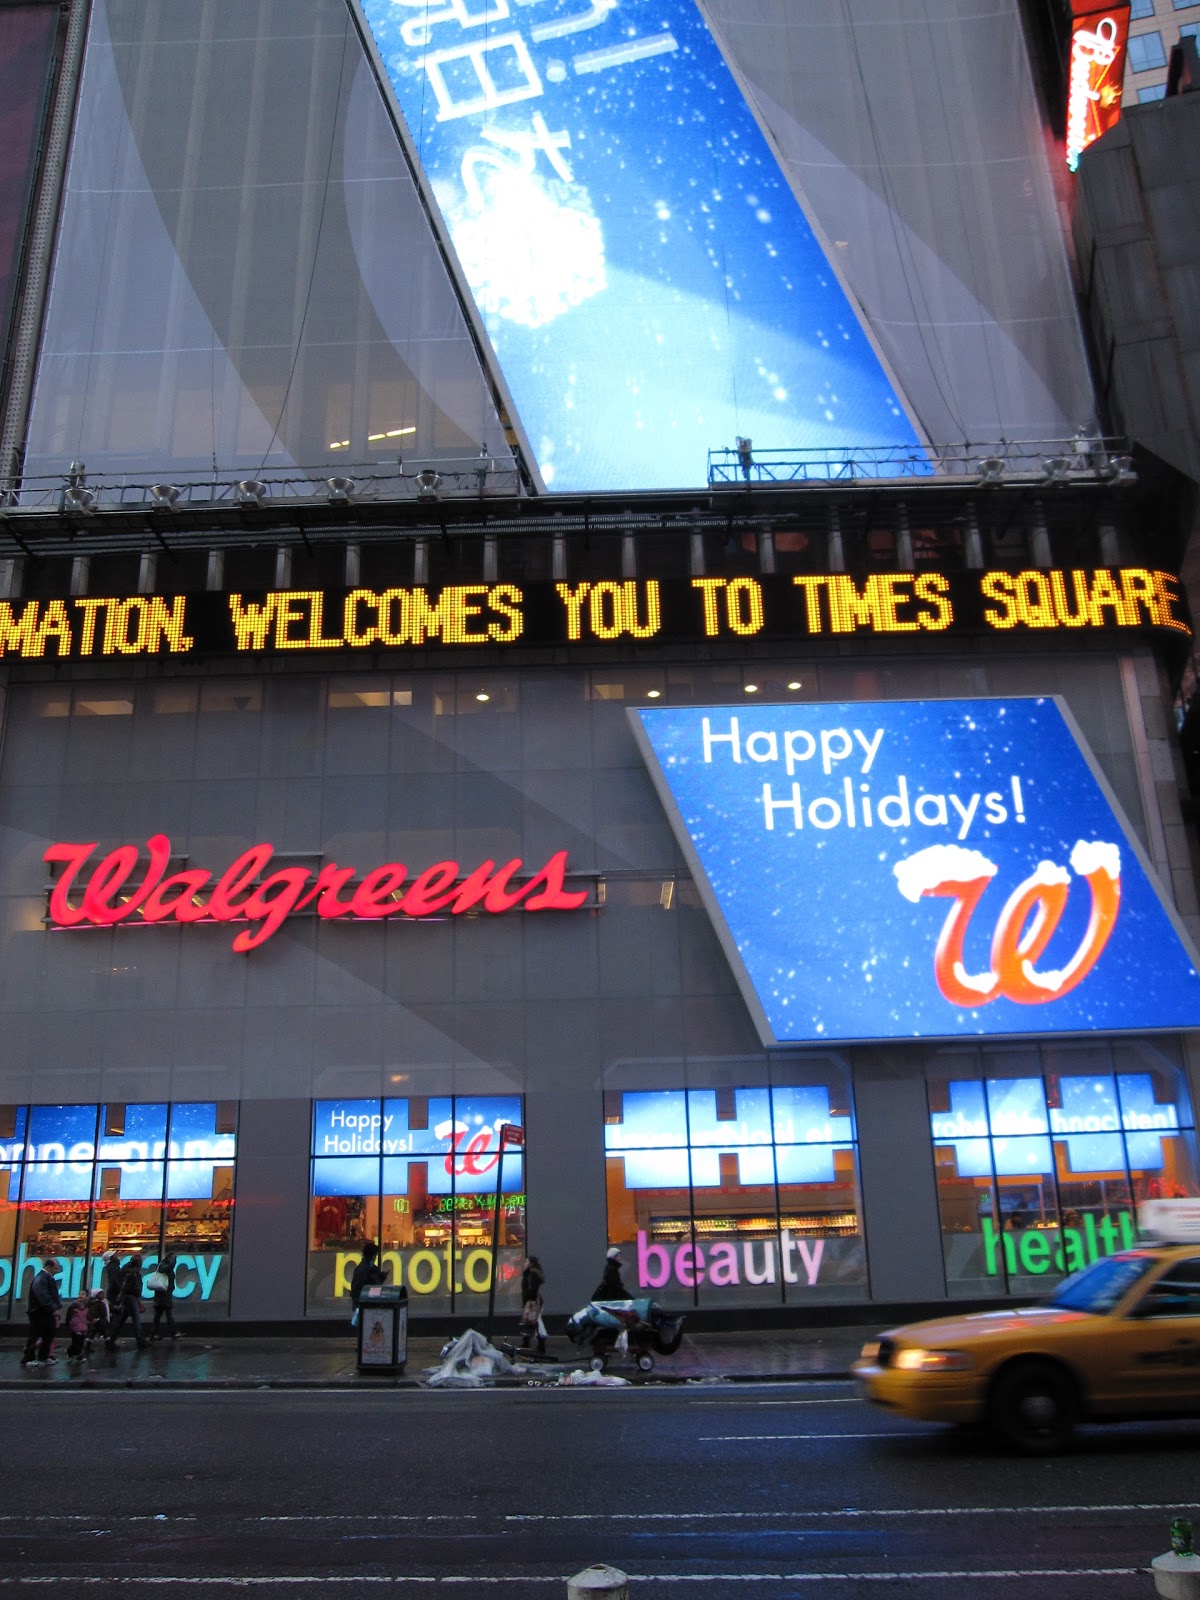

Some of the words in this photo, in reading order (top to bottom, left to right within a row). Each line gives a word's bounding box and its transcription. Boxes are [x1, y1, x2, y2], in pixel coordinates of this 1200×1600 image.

[229, 584, 524, 651] WELCOMES
[555, 580, 662, 641] YOU
[691, 577, 764, 637] TO
[793, 572, 954, 634] TIMES
[980, 568, 1193, 635] SQUARE
[701, 716, 885, 777] Happy
[762, 774, 1027, 840] Holidays!
[43, 833, 590, 953] Walgreens
[324, 1133, 413, 1154] Holidays!
[330, 1109, 394, 1133] Happy
[637, 1229, 825, 1288] beauty
